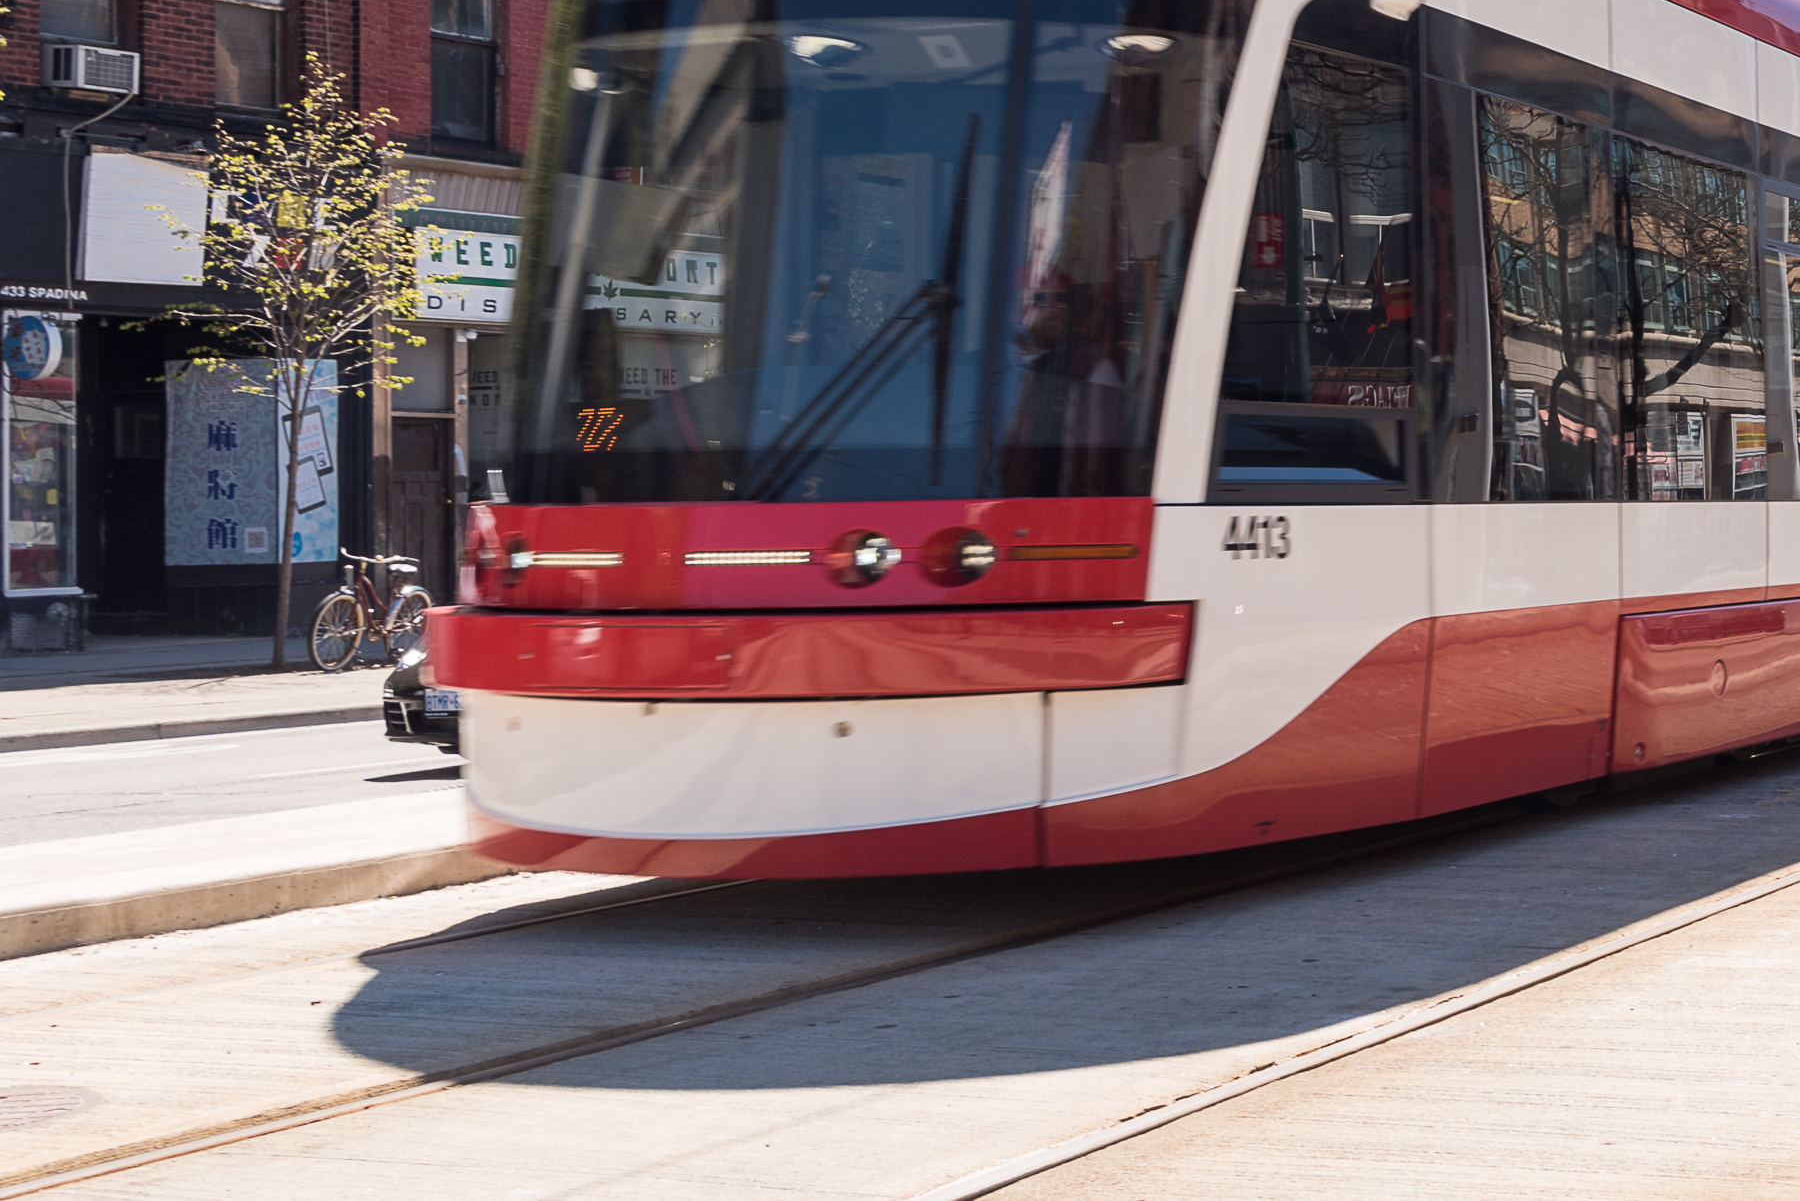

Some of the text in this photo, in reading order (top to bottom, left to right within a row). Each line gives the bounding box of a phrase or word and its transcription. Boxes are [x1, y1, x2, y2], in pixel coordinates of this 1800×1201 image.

[429, 236, 517, 269] WEED
[0, 285, 88, 301] 433 SPADINA
[1221, 516, 1292, 560] 4413
